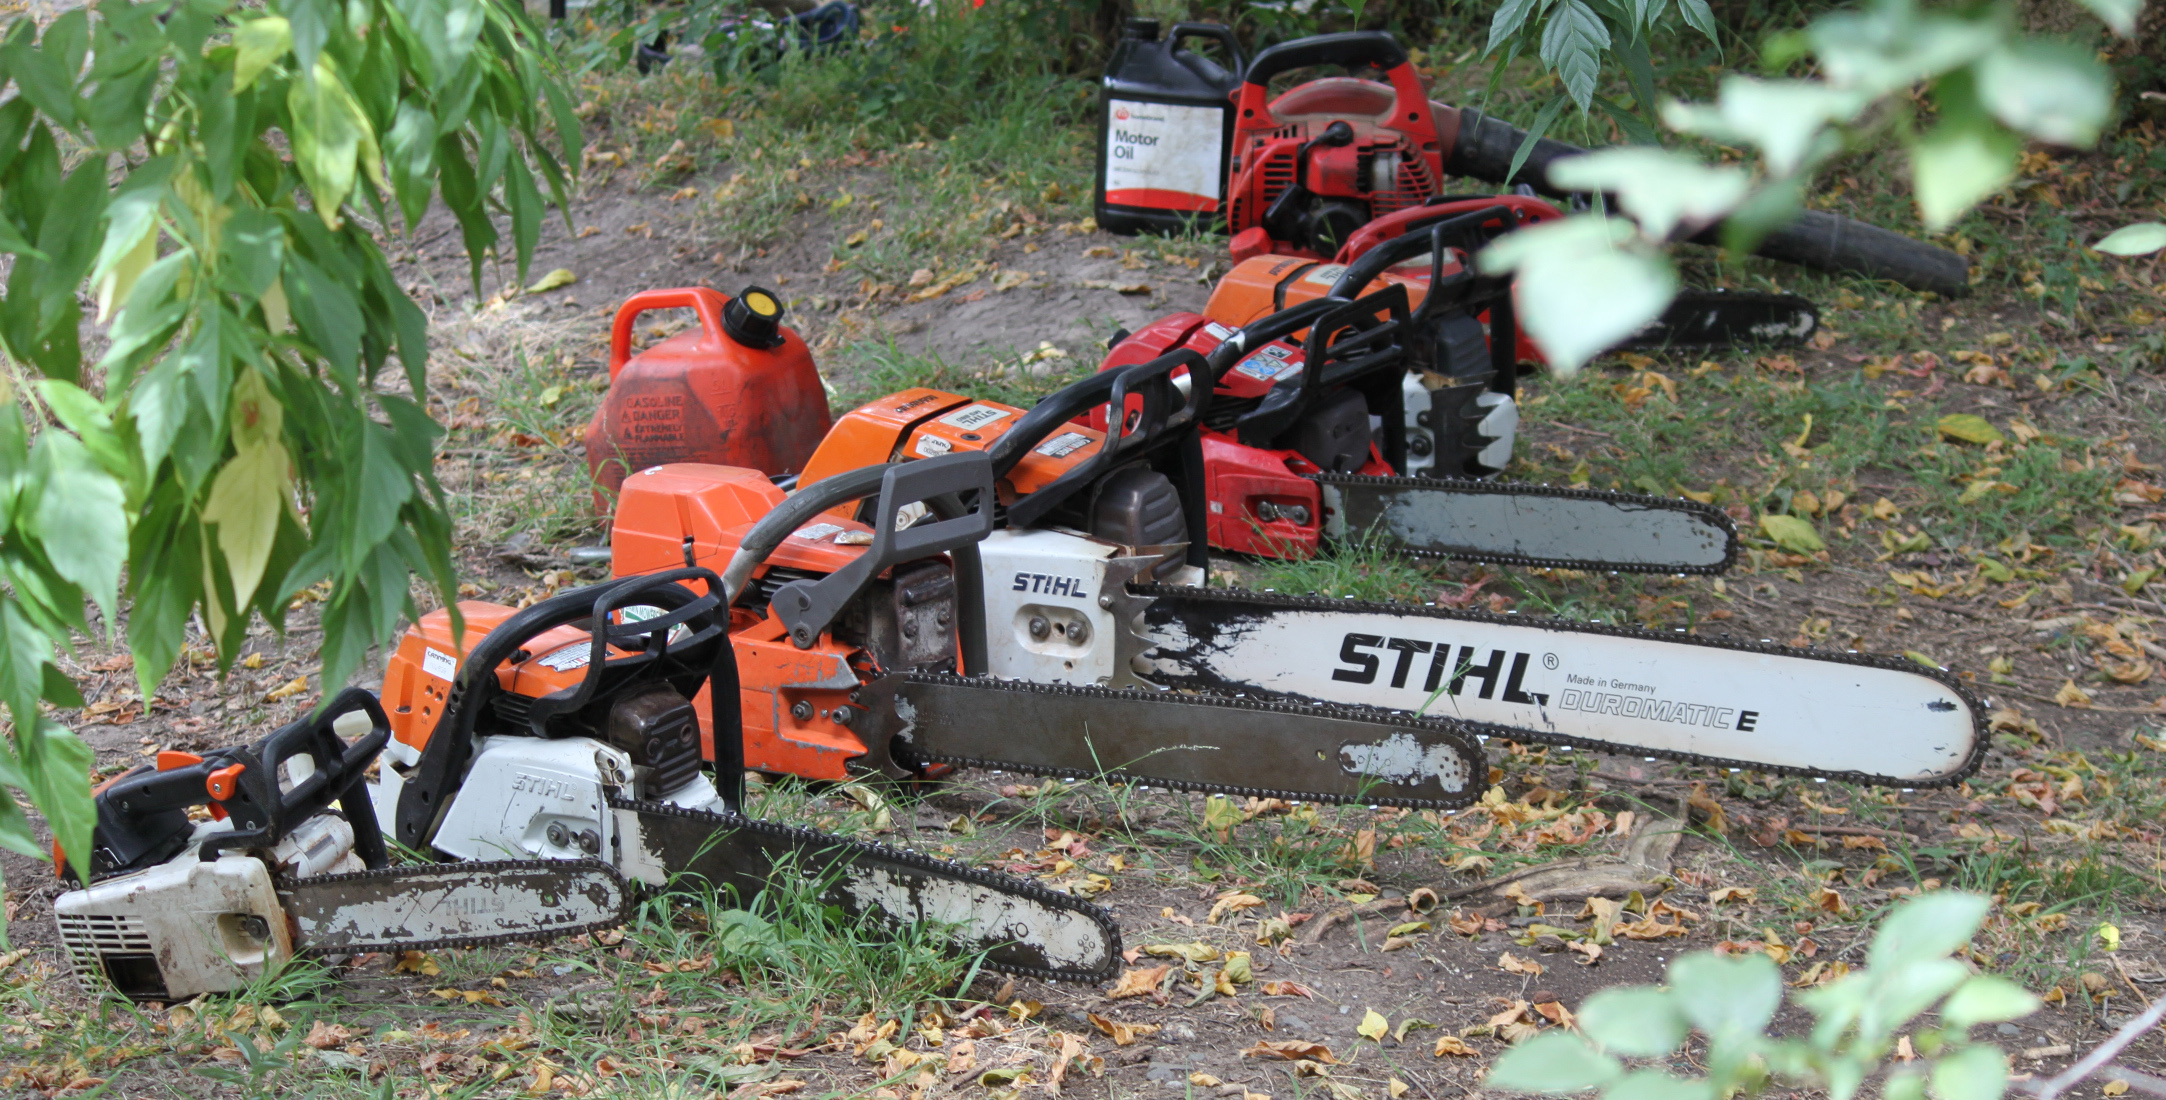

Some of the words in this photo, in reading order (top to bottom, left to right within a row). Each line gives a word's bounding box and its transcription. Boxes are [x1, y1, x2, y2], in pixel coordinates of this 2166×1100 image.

[1115, 129, 1160, 146] Motor
[1114, 145, 1134, 160] Oil
[626, 395, 684, 408] GASOLINE
[633, 409, 681, 421] DANGER
[961, 409, 998, 425] STIHL
[634, 423, 683, 434] EXTREMELY
[1012, 570, 1088, 599] STIHL
[1566, 674, 1595, 687] Made
[1597, 677, 1607, 687] in
[1610, 679, 1657, 695] Germany
[1559, 688, 1734, 730] DUROMATIC
[1736, 710, 1760, 732] E
[512, 771, 575, 802] STIHL
[440, 897, 505, 917] STIHL
